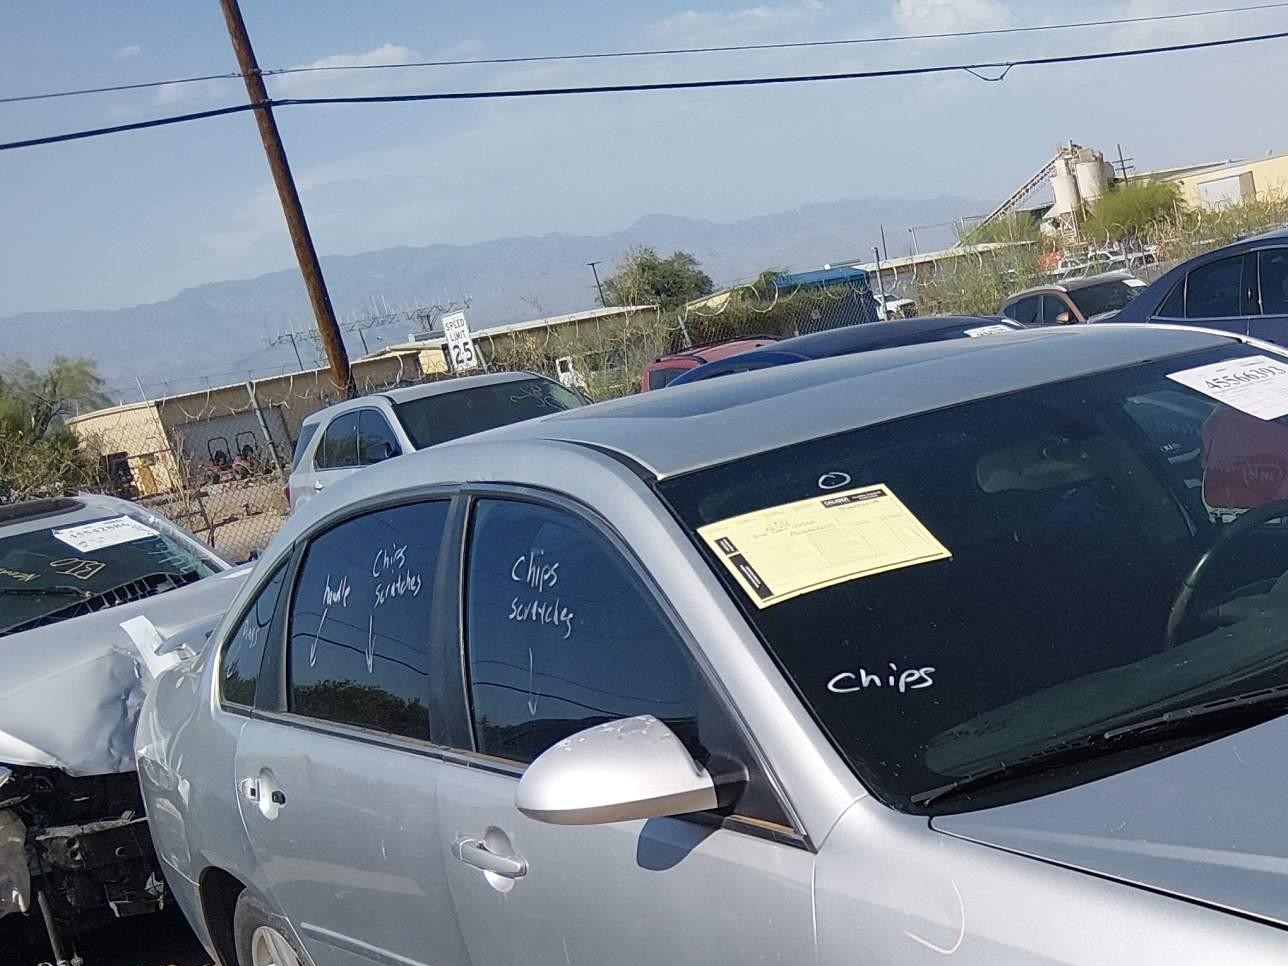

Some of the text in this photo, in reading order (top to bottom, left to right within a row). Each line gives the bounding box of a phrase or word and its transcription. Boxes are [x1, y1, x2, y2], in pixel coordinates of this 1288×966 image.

[445, 318, 465, 331] SPEED
[451, 329, 466, 342] LIMIT
[452, 341, 473, 365] 25
[1205, 365, 1287, 390] 45566393
[511, 549, 560, 593] Chips
